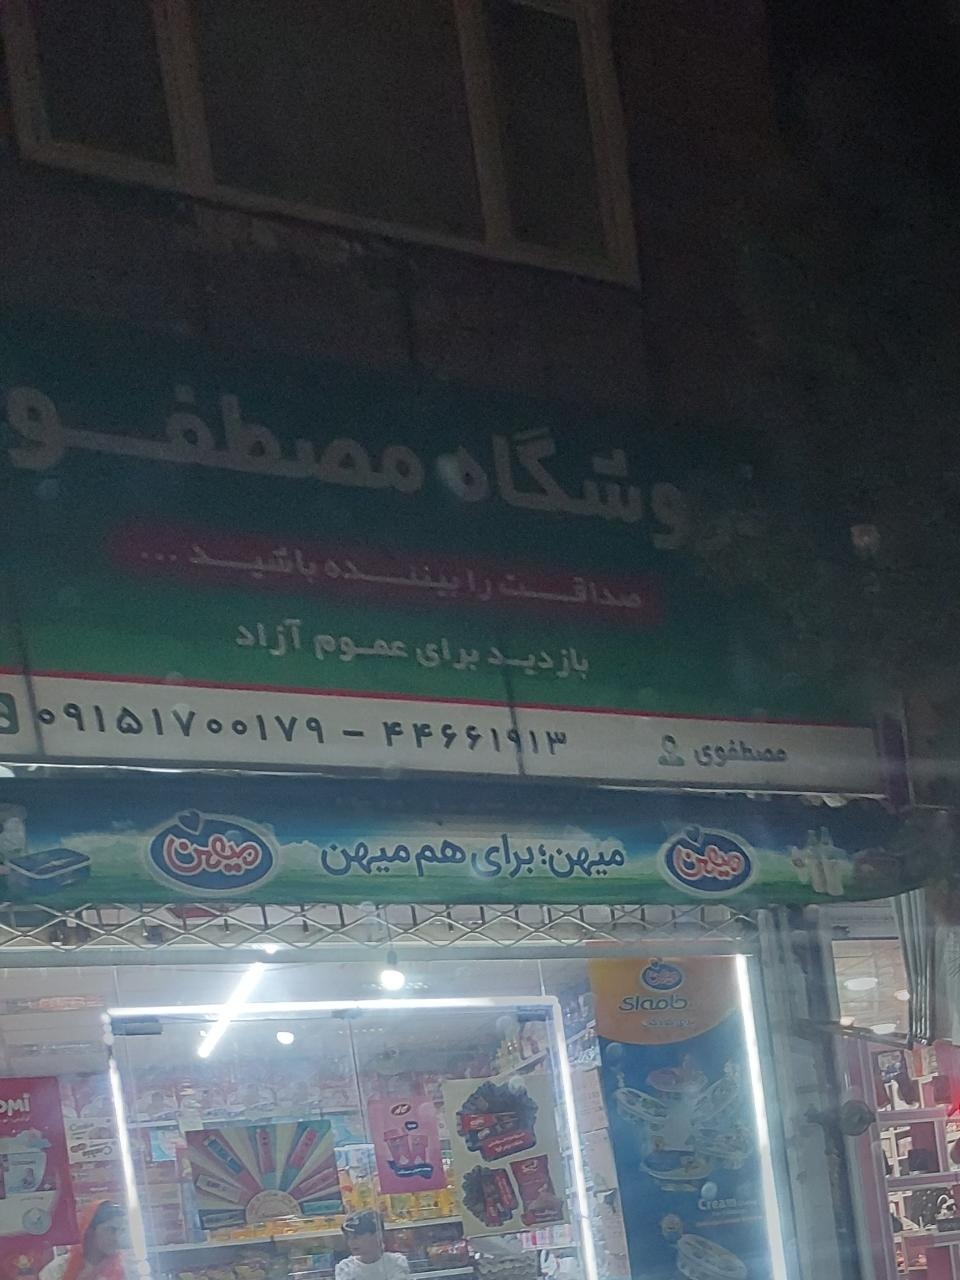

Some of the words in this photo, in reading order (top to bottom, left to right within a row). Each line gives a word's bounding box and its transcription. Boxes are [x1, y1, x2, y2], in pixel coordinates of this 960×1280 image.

[499, 573, 643, 609] صداقت
[235, 618, 301, 656] آزاد
[312, 633, 408, 660] عموم
[416, 638, 478, 671] برای
[487, 646, 590, 681] بازدید
[694, 740, 788, 767] مصطفوی
[471, 833, 534, 878] برای
